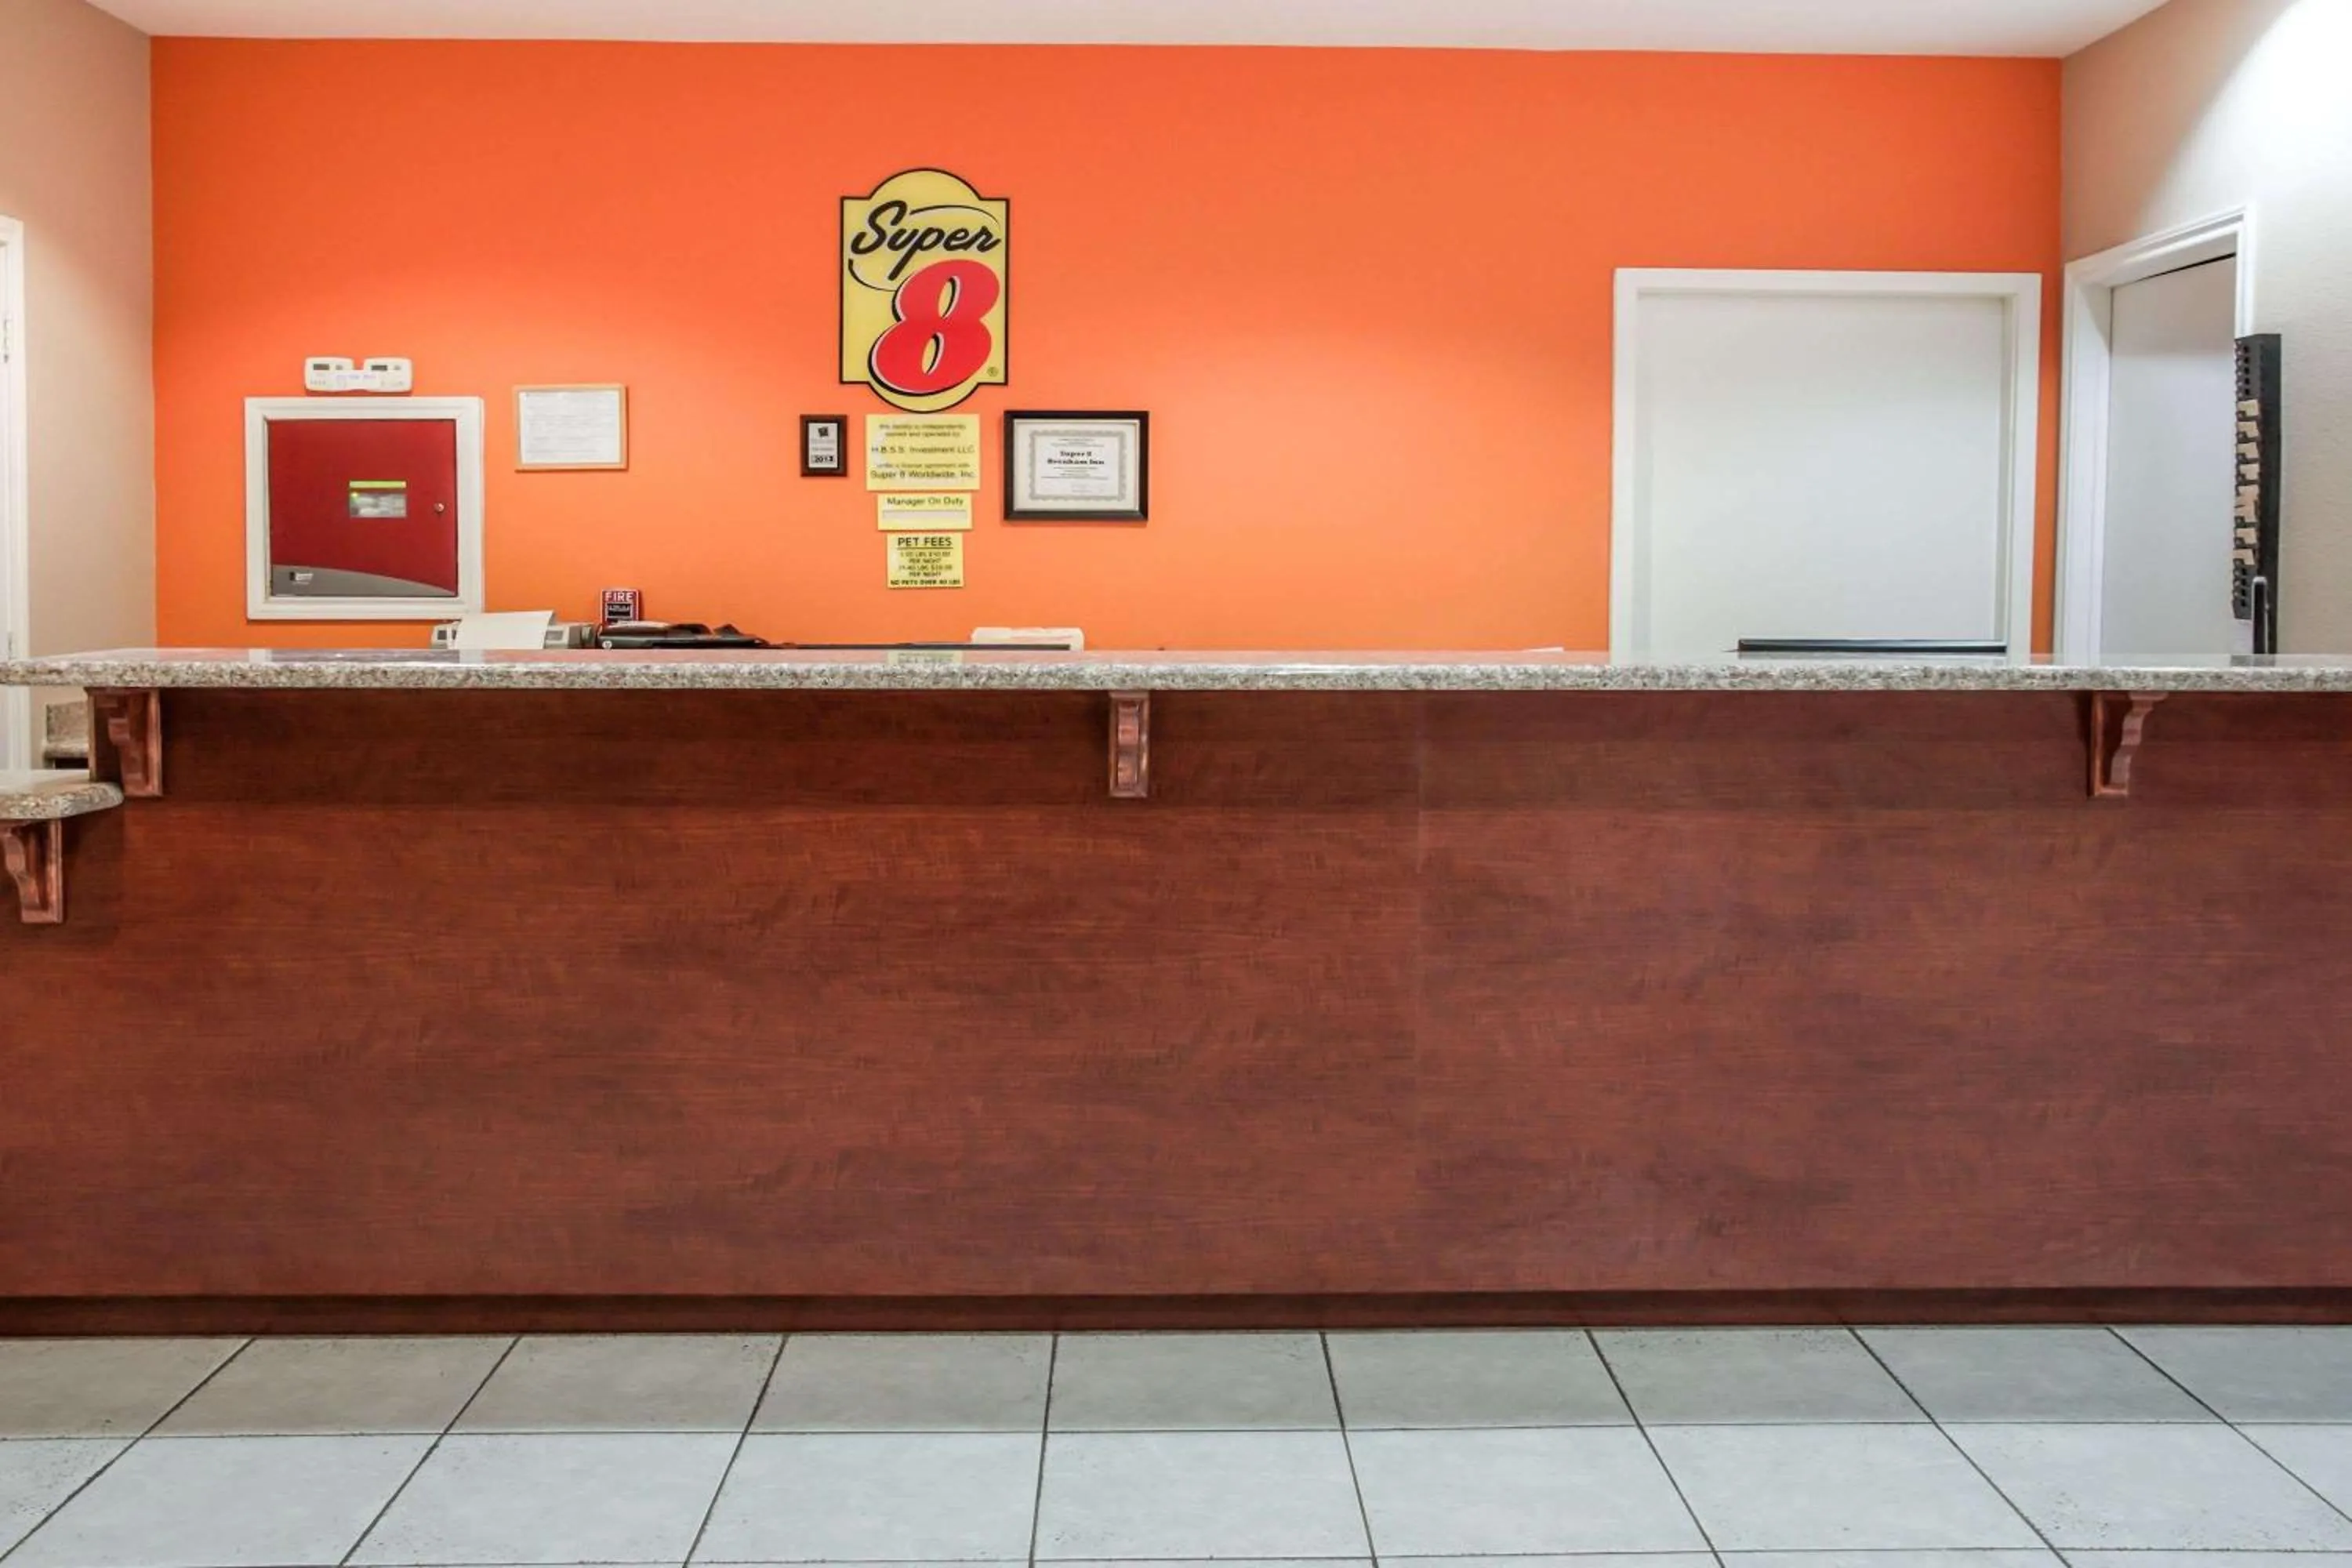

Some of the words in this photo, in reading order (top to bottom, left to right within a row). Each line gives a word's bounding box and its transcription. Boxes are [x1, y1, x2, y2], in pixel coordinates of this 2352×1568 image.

[851, 200, 1001, 281] Super
[868, 259, 1000, 397] 8
[870, 470, 896, 479] Super
[887, 497, 924, 506] Manager
[944, 497, 964, 506] Duty
[898, 537, 920, 546] PET
[924, 537, 953, 546] FEES
[605, 592, 634, 601] FIRE
